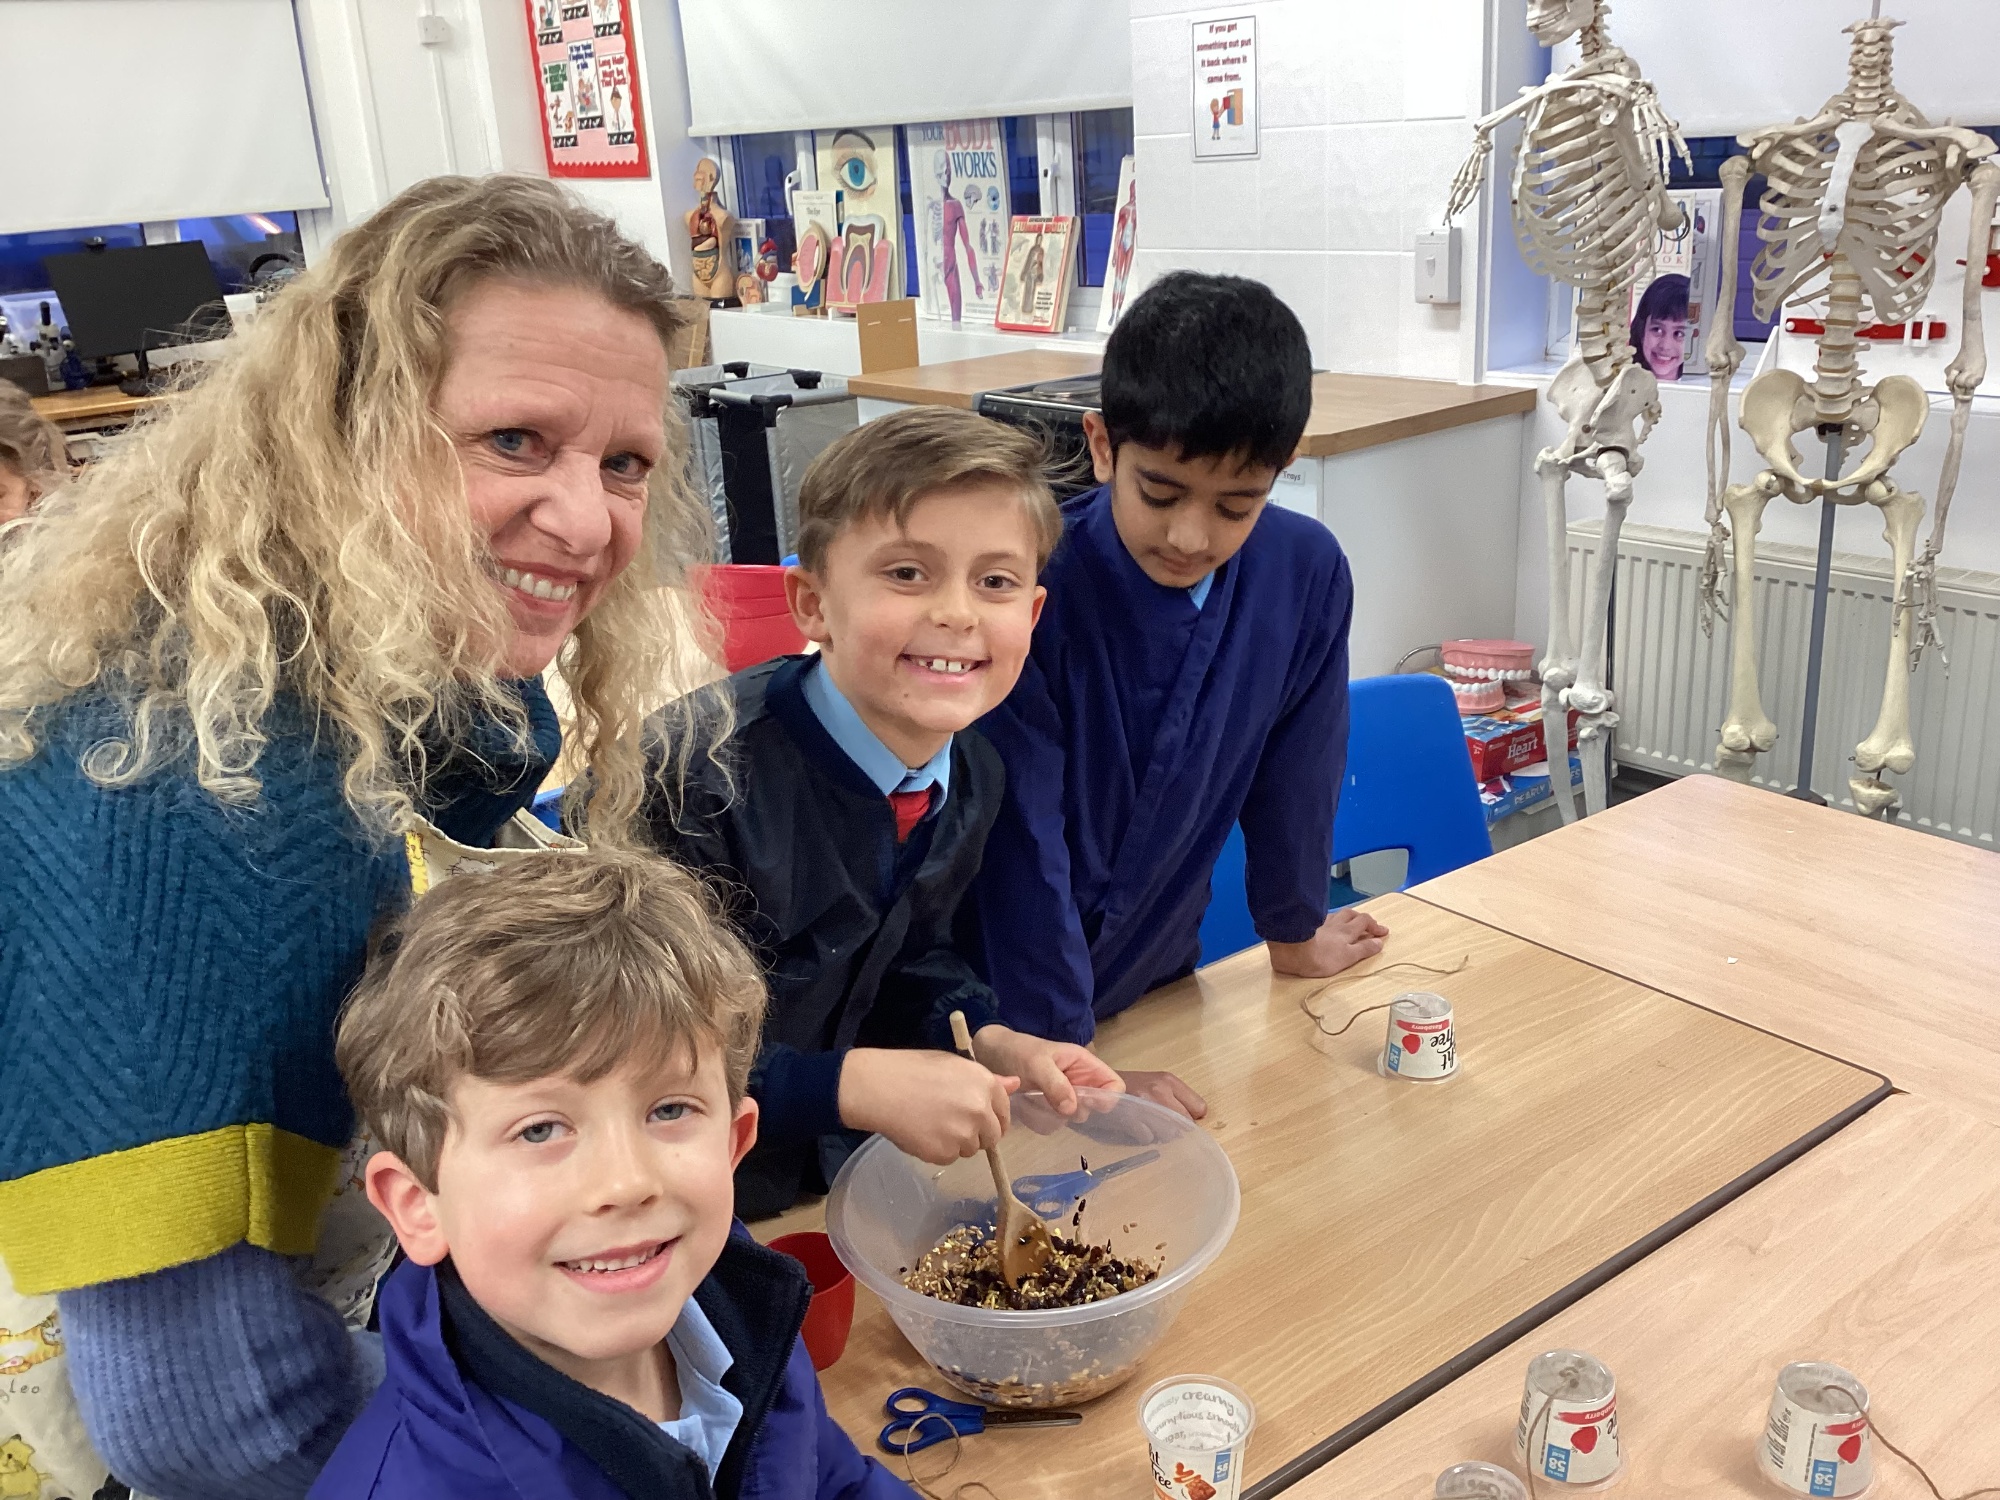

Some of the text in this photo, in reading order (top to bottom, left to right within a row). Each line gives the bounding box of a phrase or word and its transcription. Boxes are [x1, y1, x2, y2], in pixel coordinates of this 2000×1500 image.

[1209, 22, 1237, 34] If you get
[1196, 37, 1251, 51] something out put
[1201, 54, 1247, 67] it back where it
[1207, 72, 1241, 83] came from.
[922, 117, 994, 151] YOUR BODY
[951, 151, 997, 178] WORKS
[1282, 470, 1302, 481] Trays
[1507, 737, 1538, 759] Heart
[1514, 783, 1546, 805] PEARLY
[9, 1378, 40, 1394] Leo
[1182, 1391, 1234, 1416] creamy
[1216, 1463, 1229, 1474] 58
[1549, 1457, 1567, 1473] 58
[1814, 1473, 1834, 1486] 58
